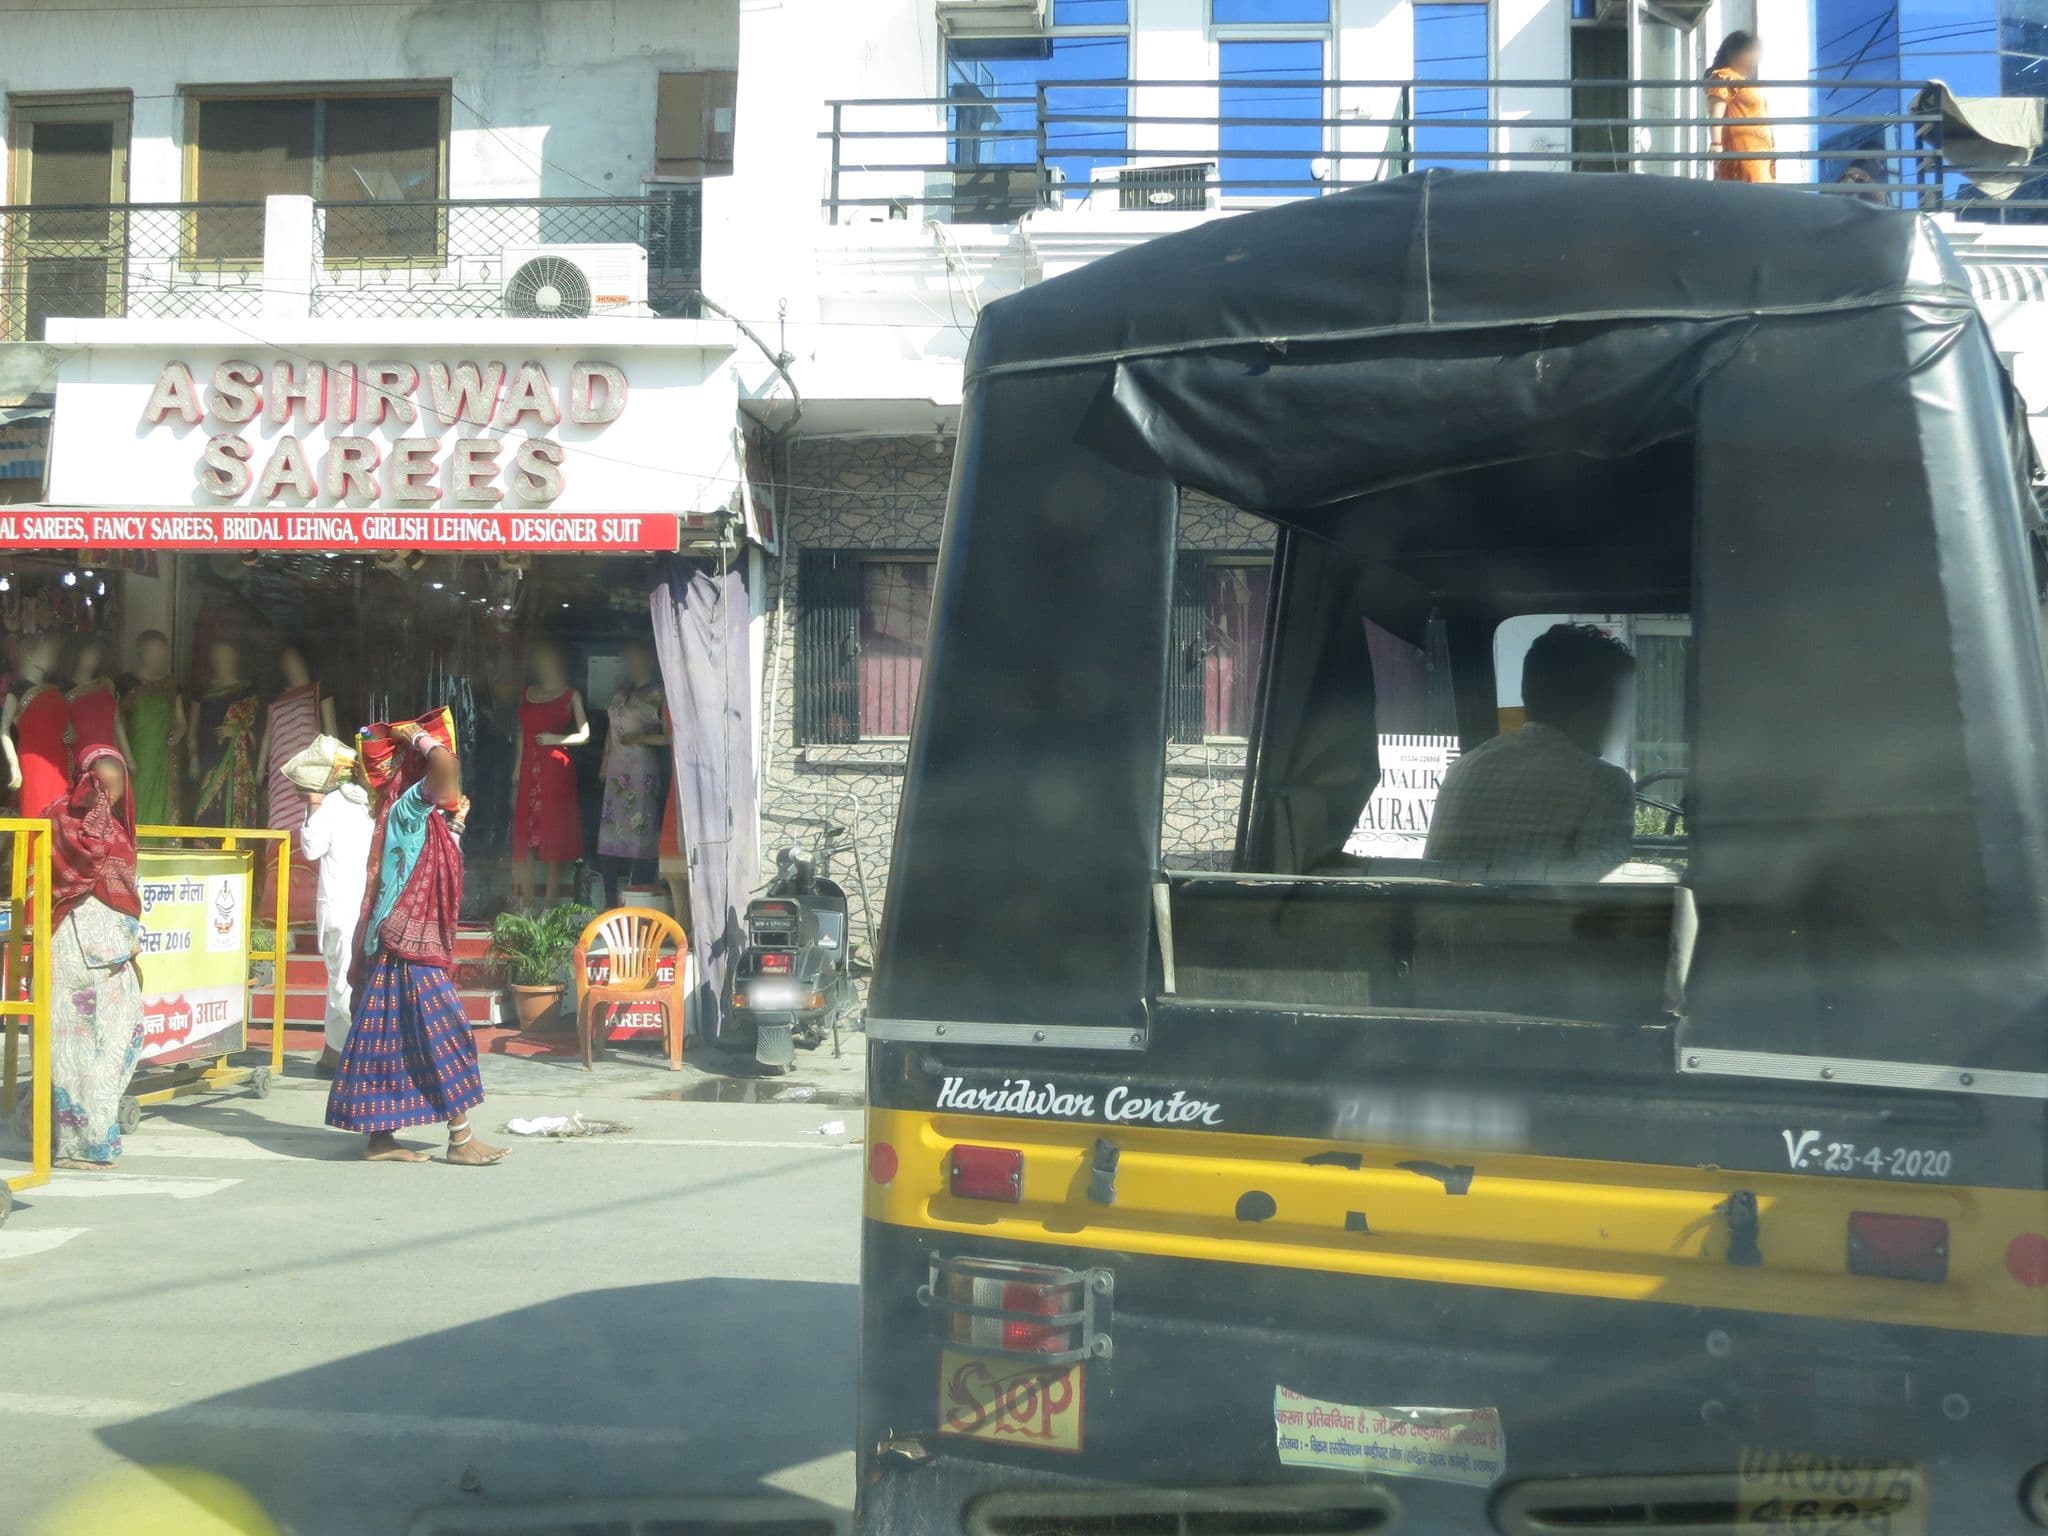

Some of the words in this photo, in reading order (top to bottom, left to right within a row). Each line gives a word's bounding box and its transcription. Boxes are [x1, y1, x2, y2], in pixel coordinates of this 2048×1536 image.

[144, 359, 628, 425] ASHIRWAD
[202, 432, 566, 502] SAREES
[23, 517, 89, 543] SAREES,
[93, 517, 147, 540] FANCY
[151, 517, 219, 544] SAREES,
[223, 517, 283, 541] BRIDAL
[288, 518, 359, 545] LEHNGA,
[362, 516, 428, 541] GIRLISH
[433, 518, 507, 546] LEHNGA,
[511, 518, 597, 543] DESIGNER
[601, 518, 642, 543] SUIT
[1356, 798, 1437, 831] AURAN
[143, 883, 176, 912] कुम्भ
[179, 876, 204, 902] मेला
[165, 931, 191, 951] 2016
[196, 1000, 228, 1025] आटा
[605, 1012, 662, 1029] AREES
[937, 1076, 1095, 1117] Haridwar
[1104, 1085, 1224, 1125] Center
